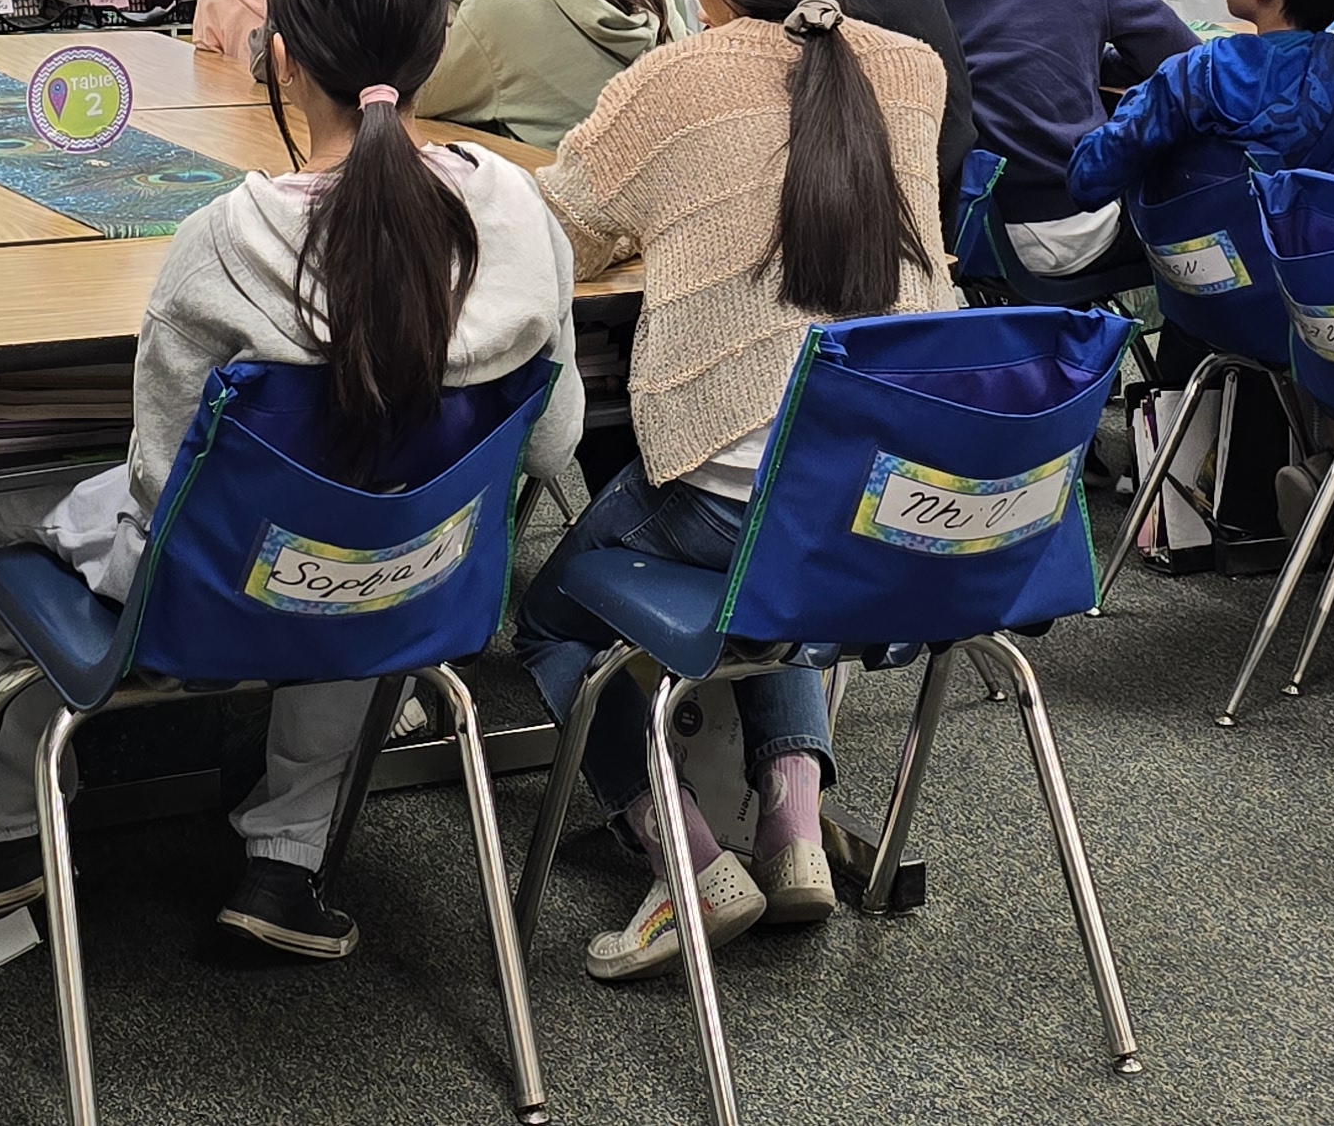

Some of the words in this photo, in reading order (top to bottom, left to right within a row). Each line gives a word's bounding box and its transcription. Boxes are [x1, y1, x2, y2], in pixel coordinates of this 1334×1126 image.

[70, 73, 115, 91] Table
[85, 93, 103, 118] 2
[269, 561, 415, 599] Sophia
